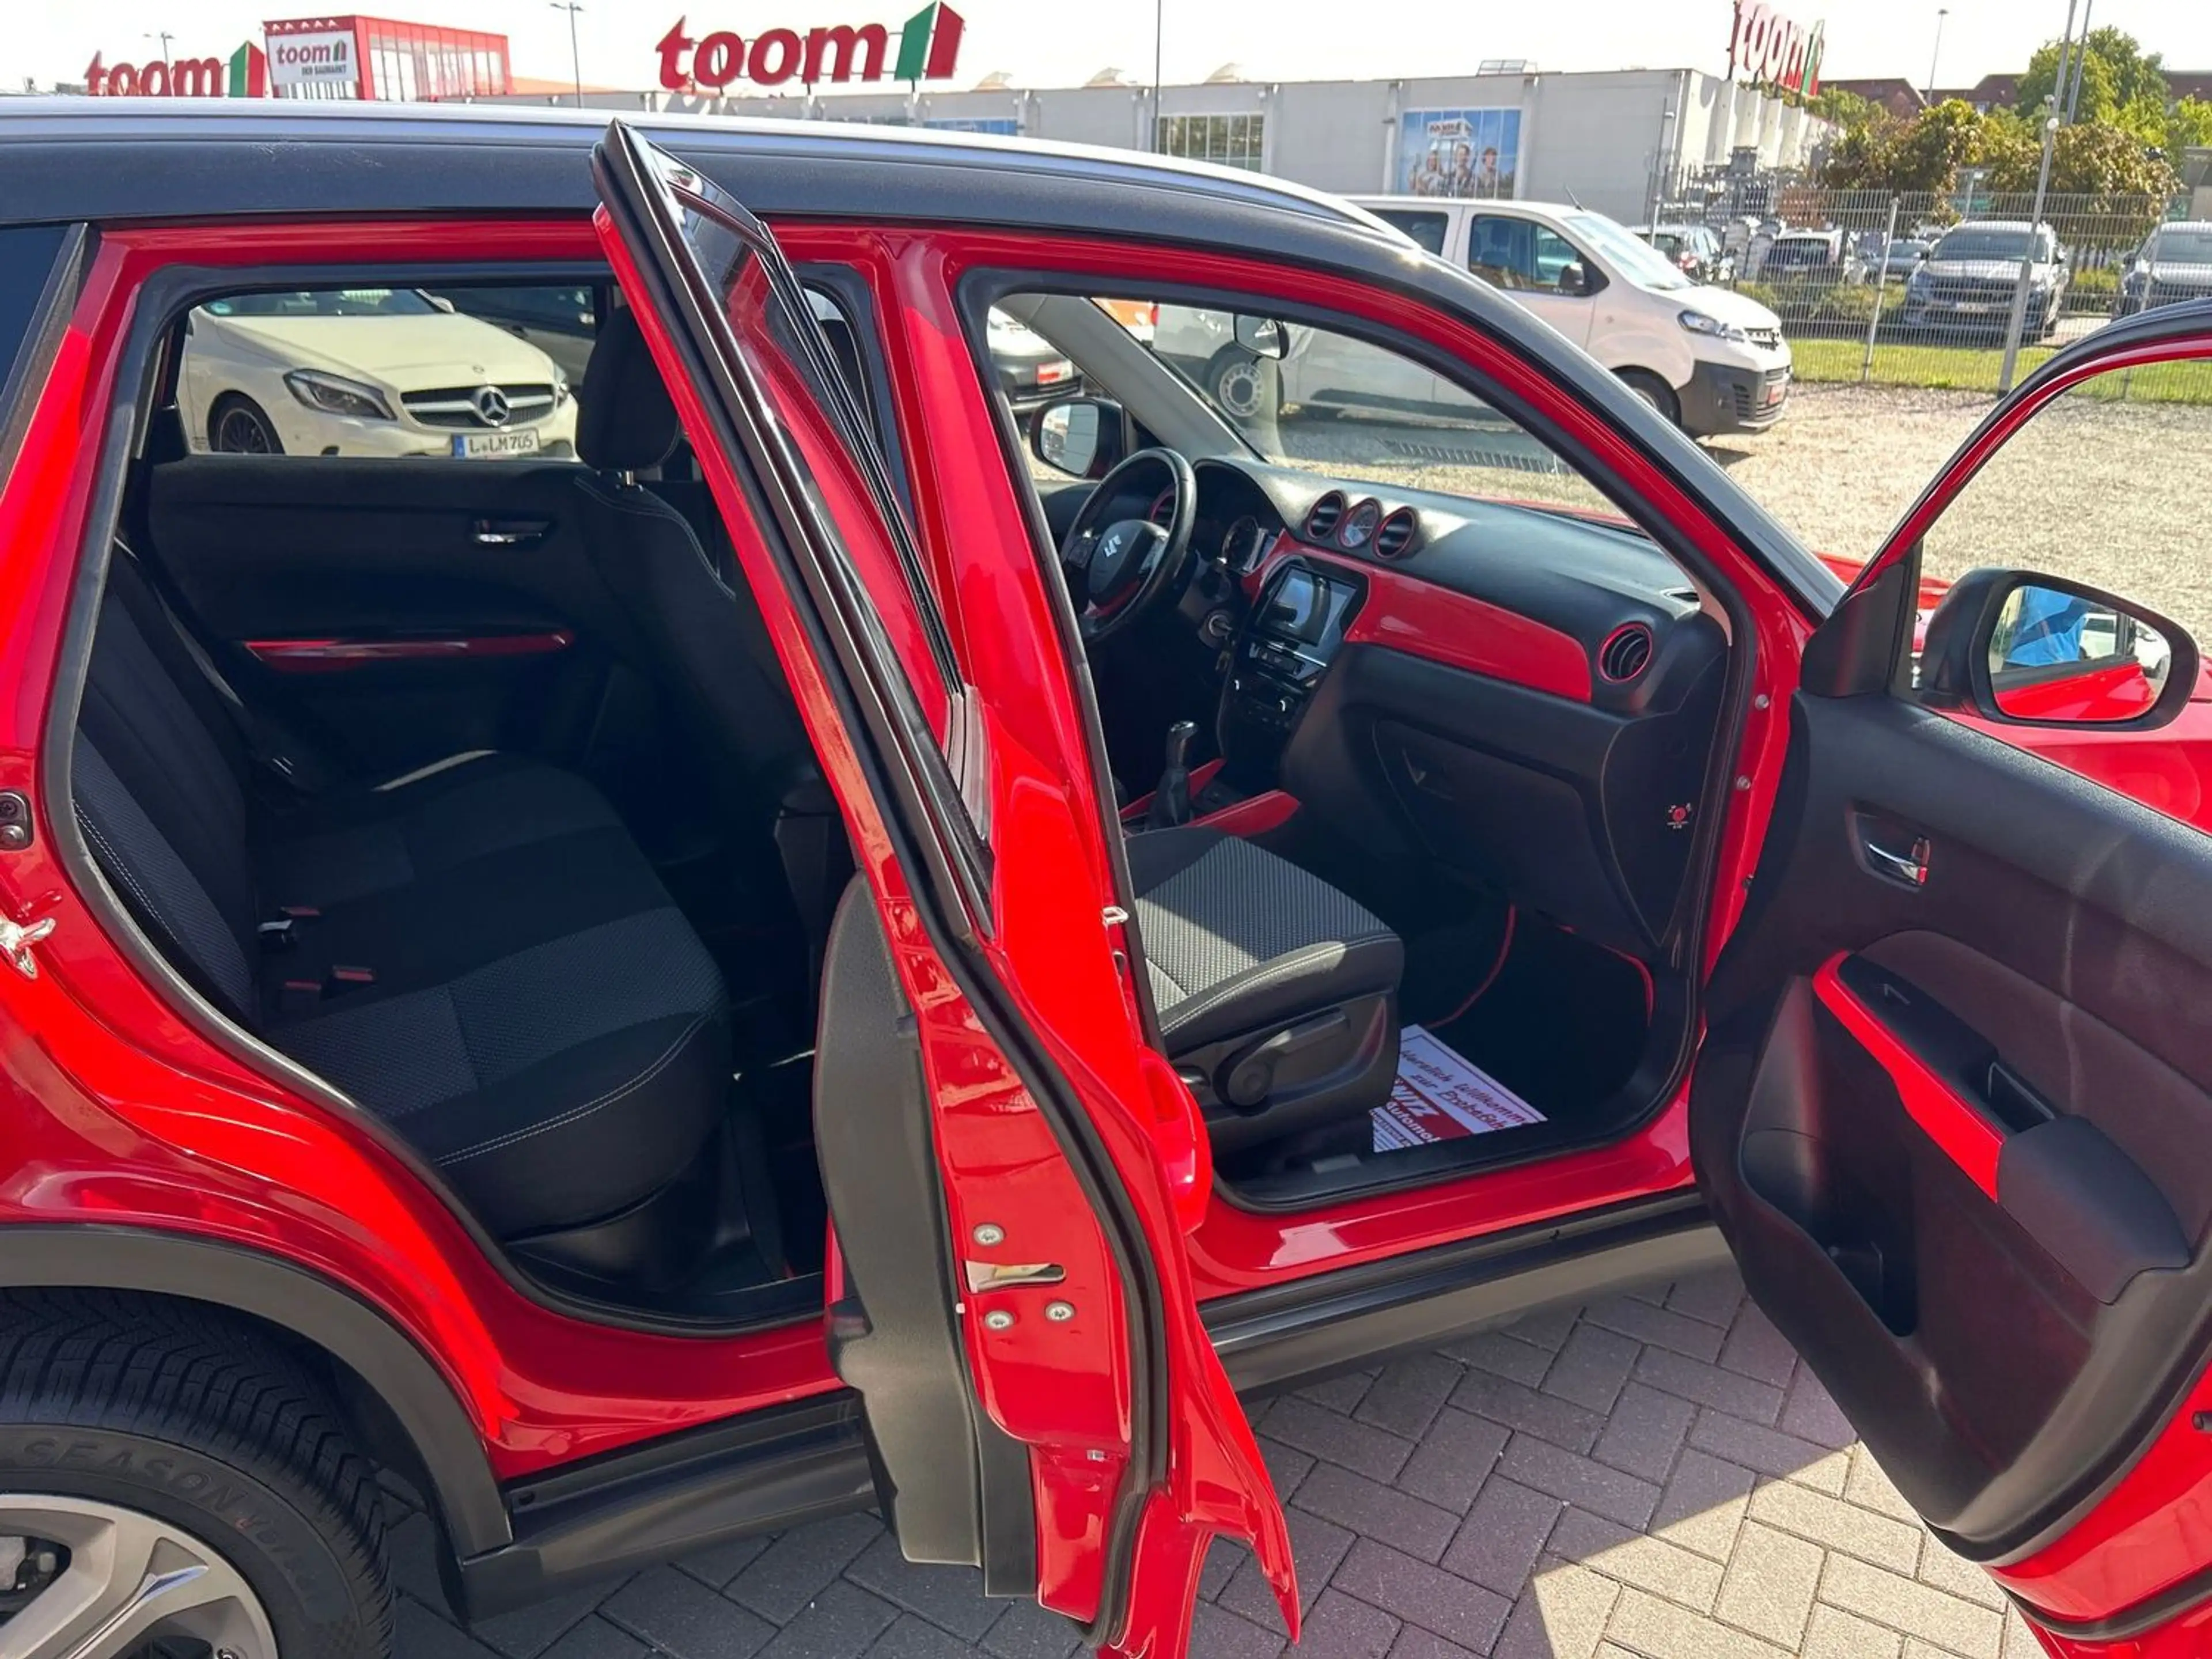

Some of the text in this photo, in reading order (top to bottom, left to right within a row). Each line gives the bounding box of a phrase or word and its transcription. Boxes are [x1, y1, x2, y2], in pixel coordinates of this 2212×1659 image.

[84, 49, 222, 97] toom
[276, 43, 331, 65] toom
[656, 15, 888, 90] toom
[1730, 0, 1802, 93] toom
